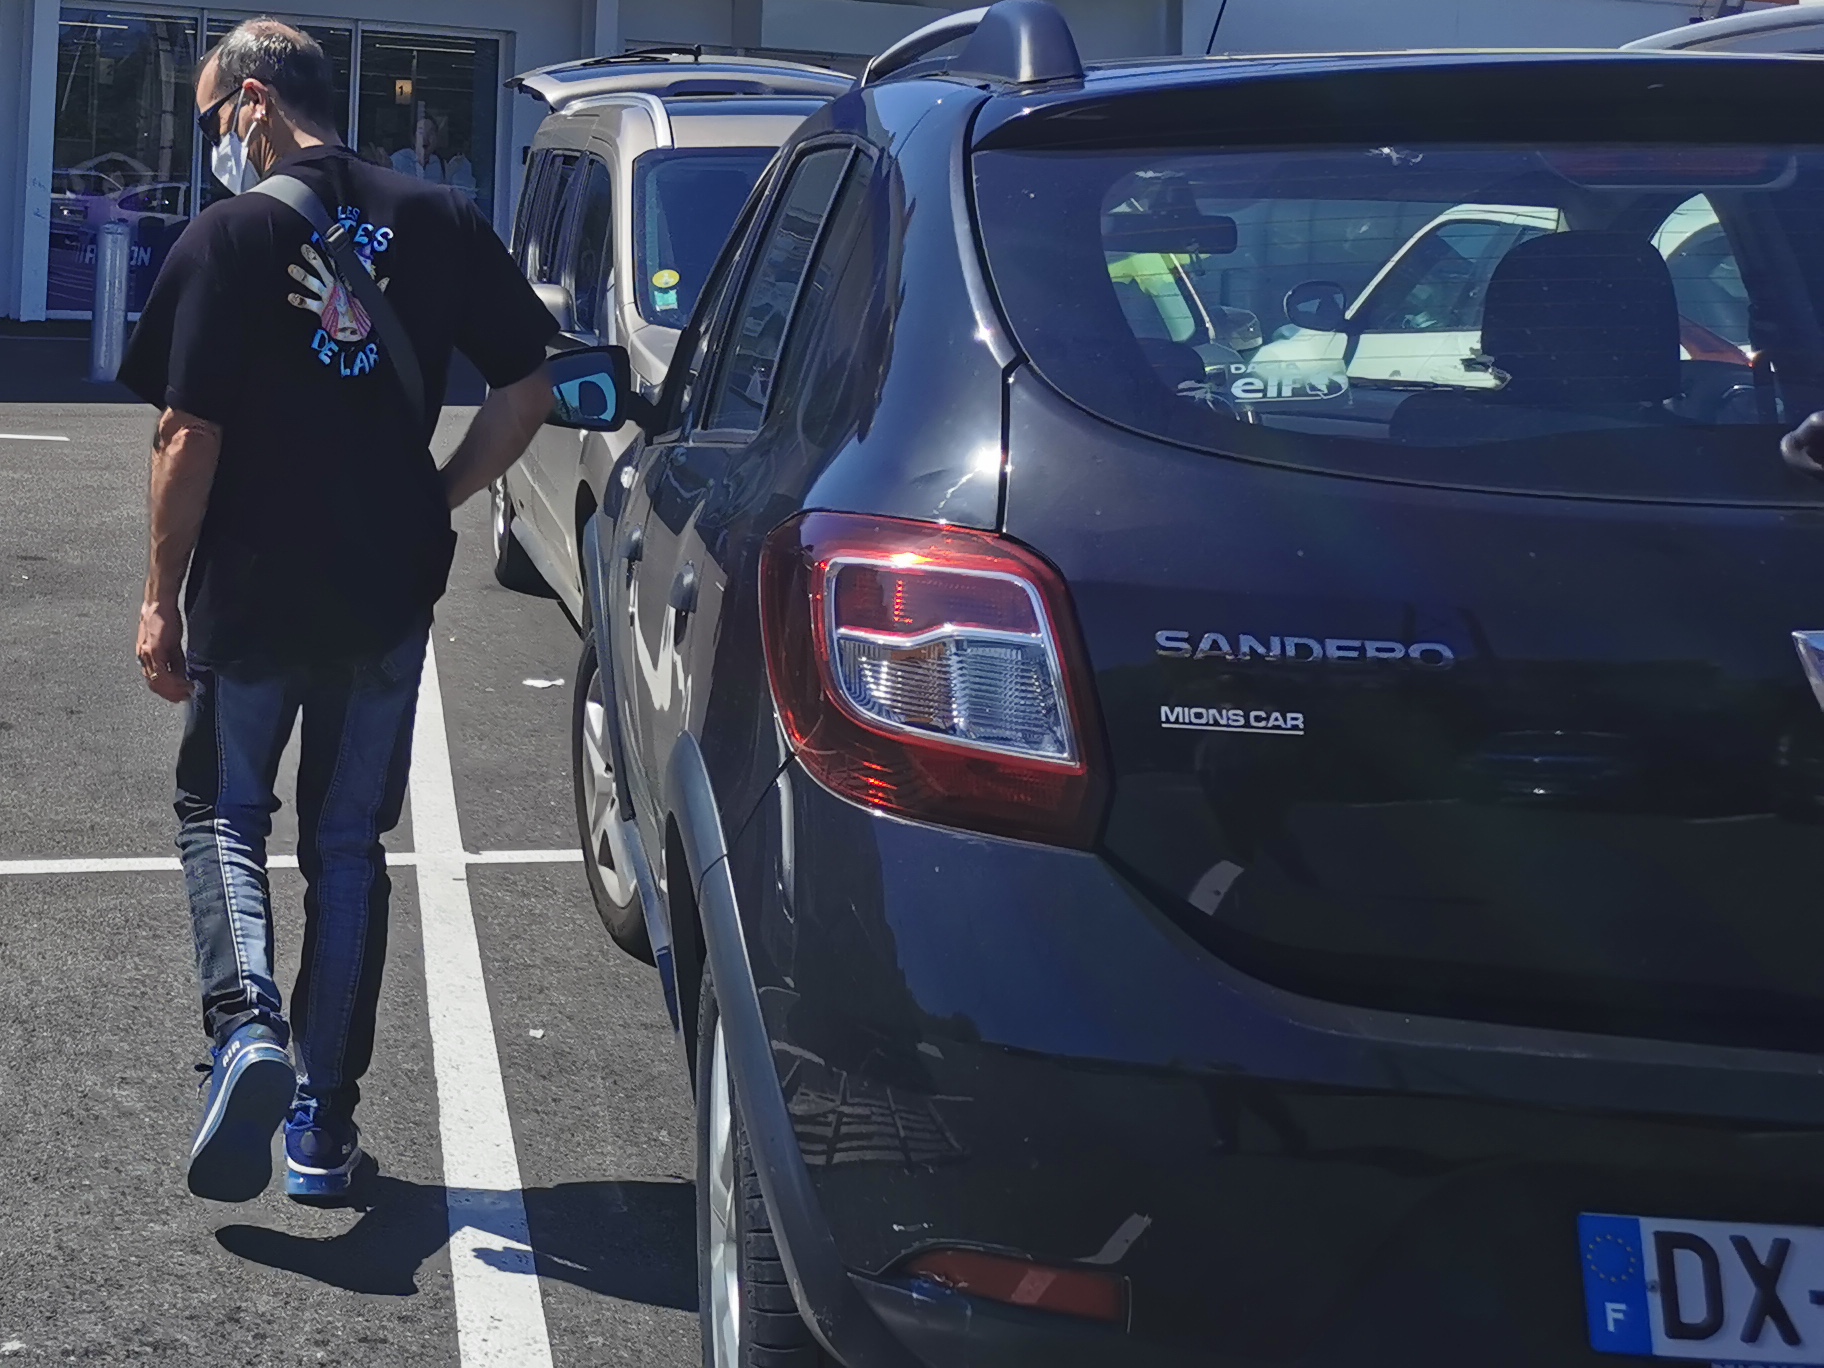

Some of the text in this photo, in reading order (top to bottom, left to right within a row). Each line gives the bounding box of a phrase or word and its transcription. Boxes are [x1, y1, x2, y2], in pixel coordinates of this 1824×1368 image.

[398, 85, 404, 96] 1
[337, 205, 361, 221] LES
[83, 244, 152, 267] AON
[310, 328, 339, 365] DE
[1230, 362, 1301, 375] DAIA
[1230, 374, 1303, 398] elf
[1155, 630, 1455, 670] SANDERO
[1160, 705, 1305, 730] MIONS CAR
[222, 1040, 241, 1068] AIR
[1605, 1302, 1628, 1333] F
